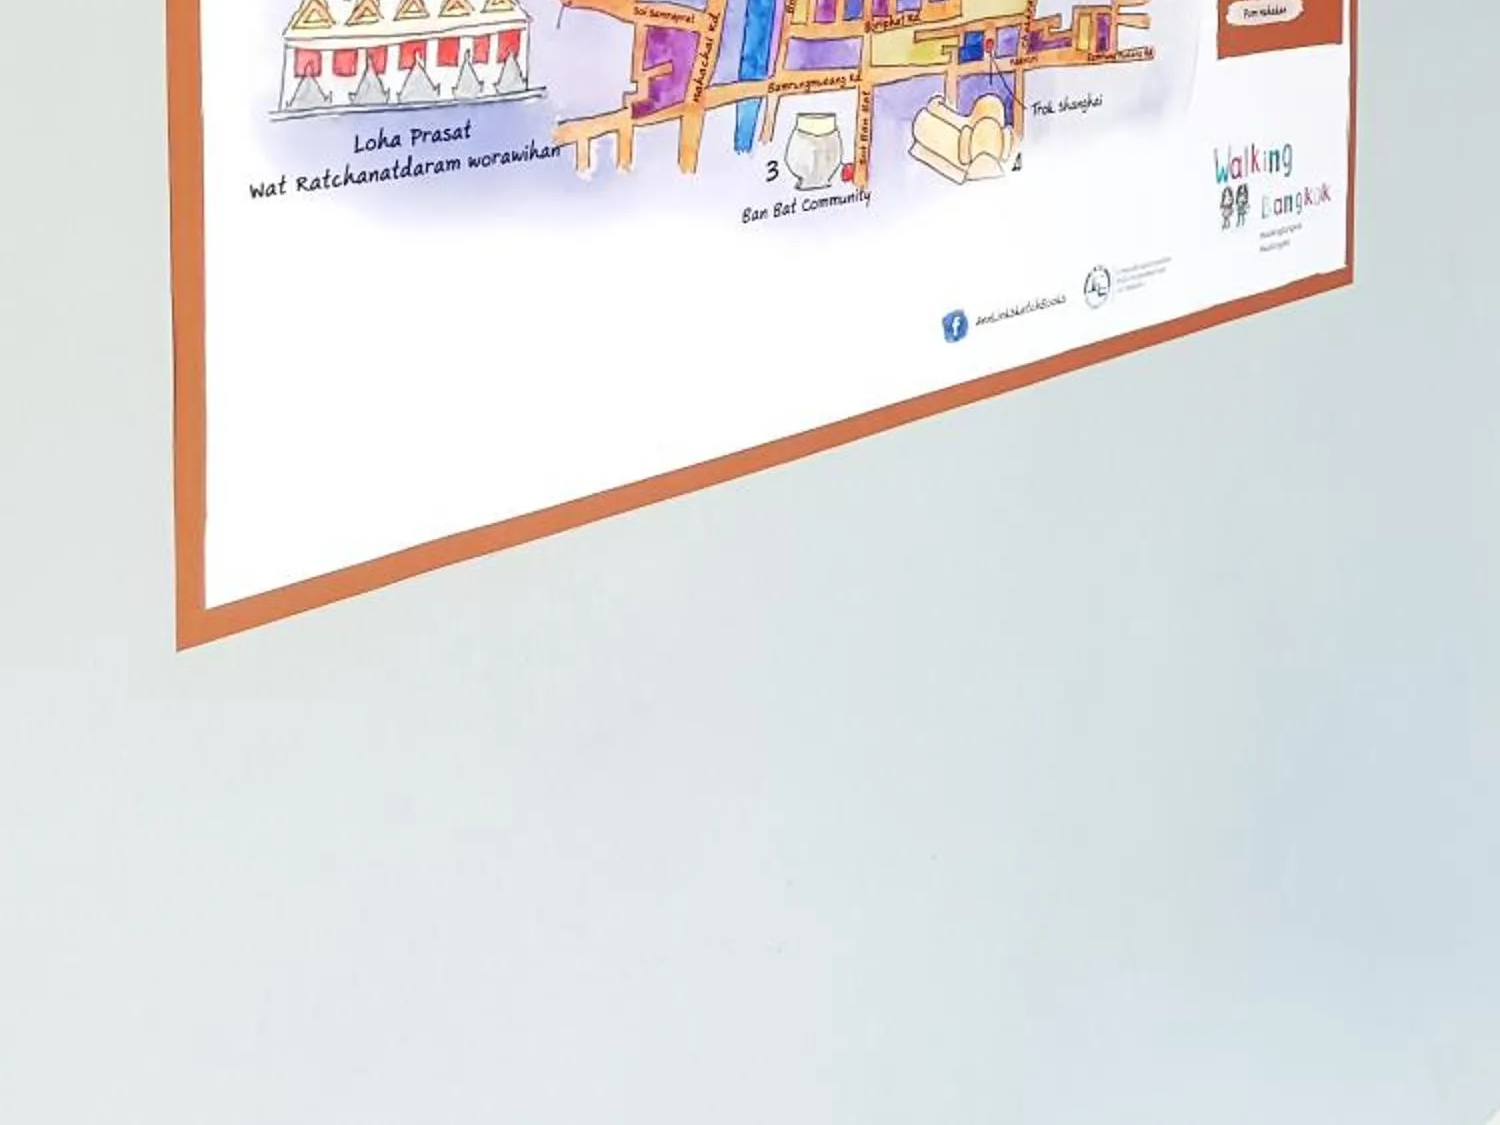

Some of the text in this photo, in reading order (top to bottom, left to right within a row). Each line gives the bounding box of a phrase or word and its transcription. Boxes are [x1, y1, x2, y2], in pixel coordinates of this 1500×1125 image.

[354, 118, 475, 154] Loha Prasat
[765, 160, 779, 182] 3
[1213, 143, 1293, 184] Walking
[742, 189, 871, 225] Ban Bat Community
